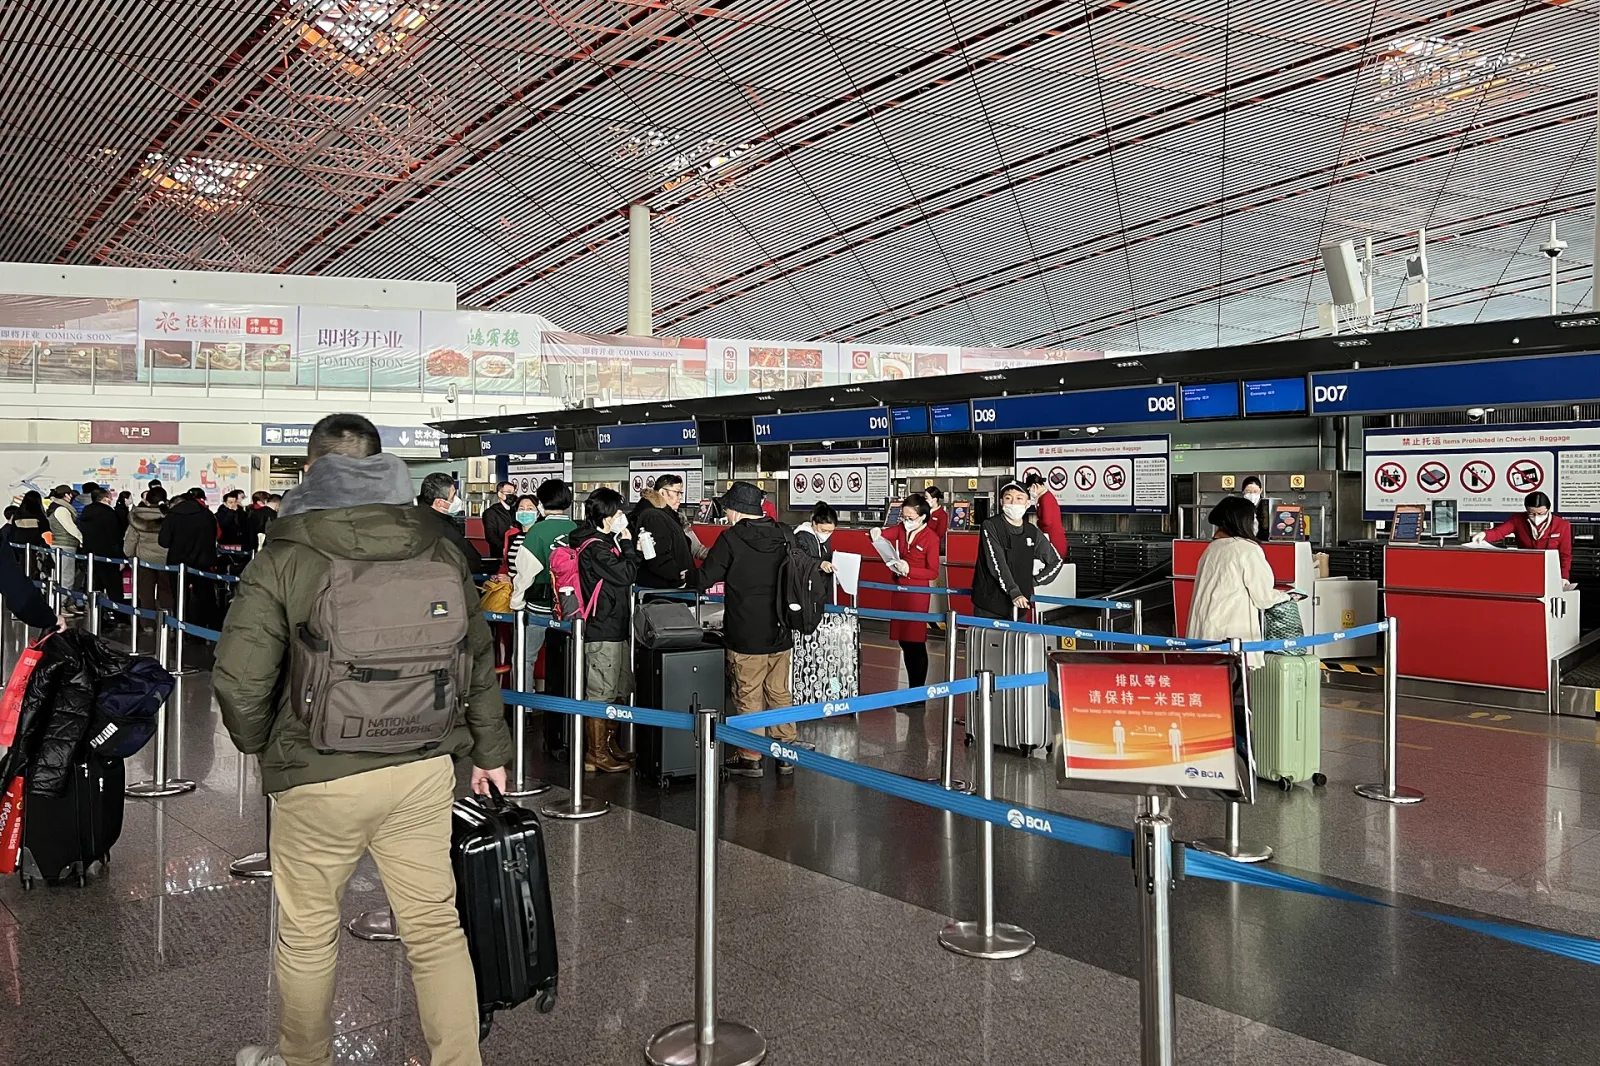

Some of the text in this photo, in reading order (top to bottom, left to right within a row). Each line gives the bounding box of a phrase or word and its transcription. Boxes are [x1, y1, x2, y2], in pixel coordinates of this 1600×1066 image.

[0, 330, 40, 339] 即将开业
[45, 331, 85, 340] COMING
[317, 328, 404, 348] 即将开业
[371, 357, 403, 367] SOON
[1314, 385, 1348, 402] D07
[1148, 396, 1176, 412] D08
[974, 408, 996, 423] D09
[869, 416, 888, 430] D10
[682, 428, 697, 439] D12
[756, 424, 771, 436] D11
[544, 436, 555, 446] D14
[599, 433, 611, 443] D13
[1402, 436, 1441, 446] 禁止托运
[1539, 435, 1570, 443] Baggage
[481, 441, 491, 449] D15
[1115, 674, 1171, 688] 排队等候
[935, 685, 949, 695] BCIA
[1088, 690, 1203, 708] 请保持一米距离
[617, 708, 633, 720] BCIA
[834, 703, 849, 713] BCIA
[367, 715, 421, 728] NATIONAL
[366, 723, 433, 738] GEOGRAPHIC
[781, 747, 799, 762] BCIA
[1200, 770, 1225, 779] BCIA
[1025, 815, 1053, 833] BCIA
